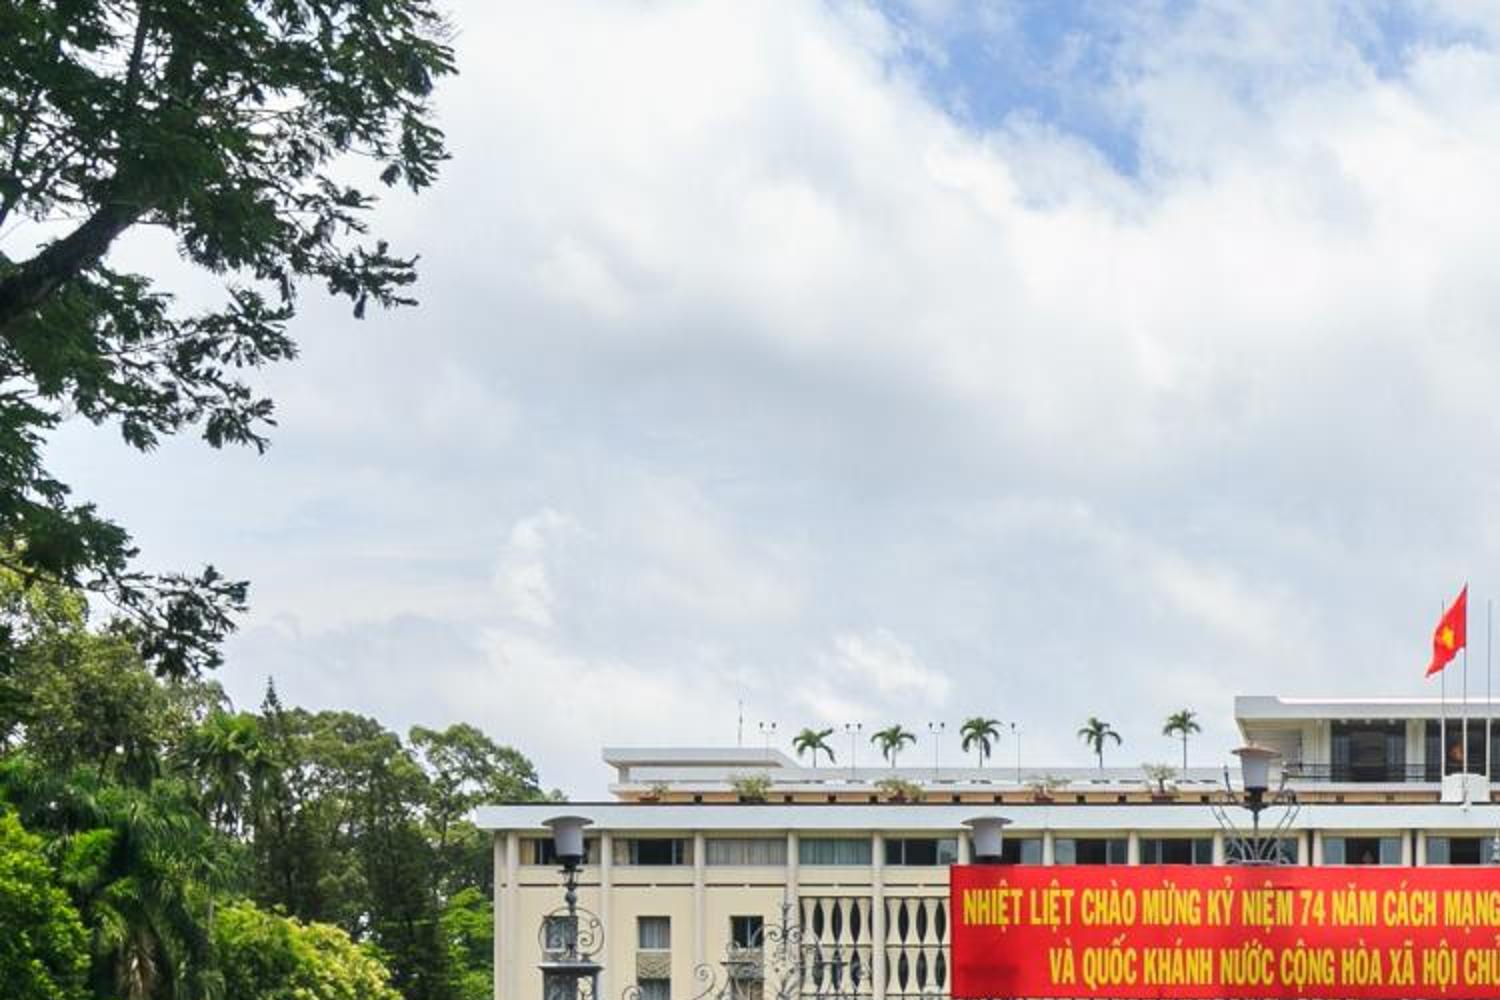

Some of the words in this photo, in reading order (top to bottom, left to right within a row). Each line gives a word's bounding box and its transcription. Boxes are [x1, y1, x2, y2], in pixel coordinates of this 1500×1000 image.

[963, 878, 1024, 932] NHIỆT
[1029, 877, 1076, 933] LIỆT
[1080, 878, 1137, 927] CHÀO
[1140, 878, 1203, 928] MỪNG
[1206, 874, 1235, 927] KỶ
[1241, 879, 1295, 934] NIỆM
[1298, 887, 1327, 928] 74
[1330, 881, 1379, 928] NĂM
[1381, 878, 1439, 929] CÁCH
[1049, 937, 1077, 985] VÀ
[1081, 933, 1138, 992] QUỐC
[1143, 937, 1214, 986] KHÁNH
[1219, 938, 1275, 986] NƯỚC
[1279, 937, 1336, 993] CỘNG
[1340, 937, 1383, 986] HÒA
[1388, 938, 1416, 987] XÃ
[1422, 937, 1458, 993] HỘI
